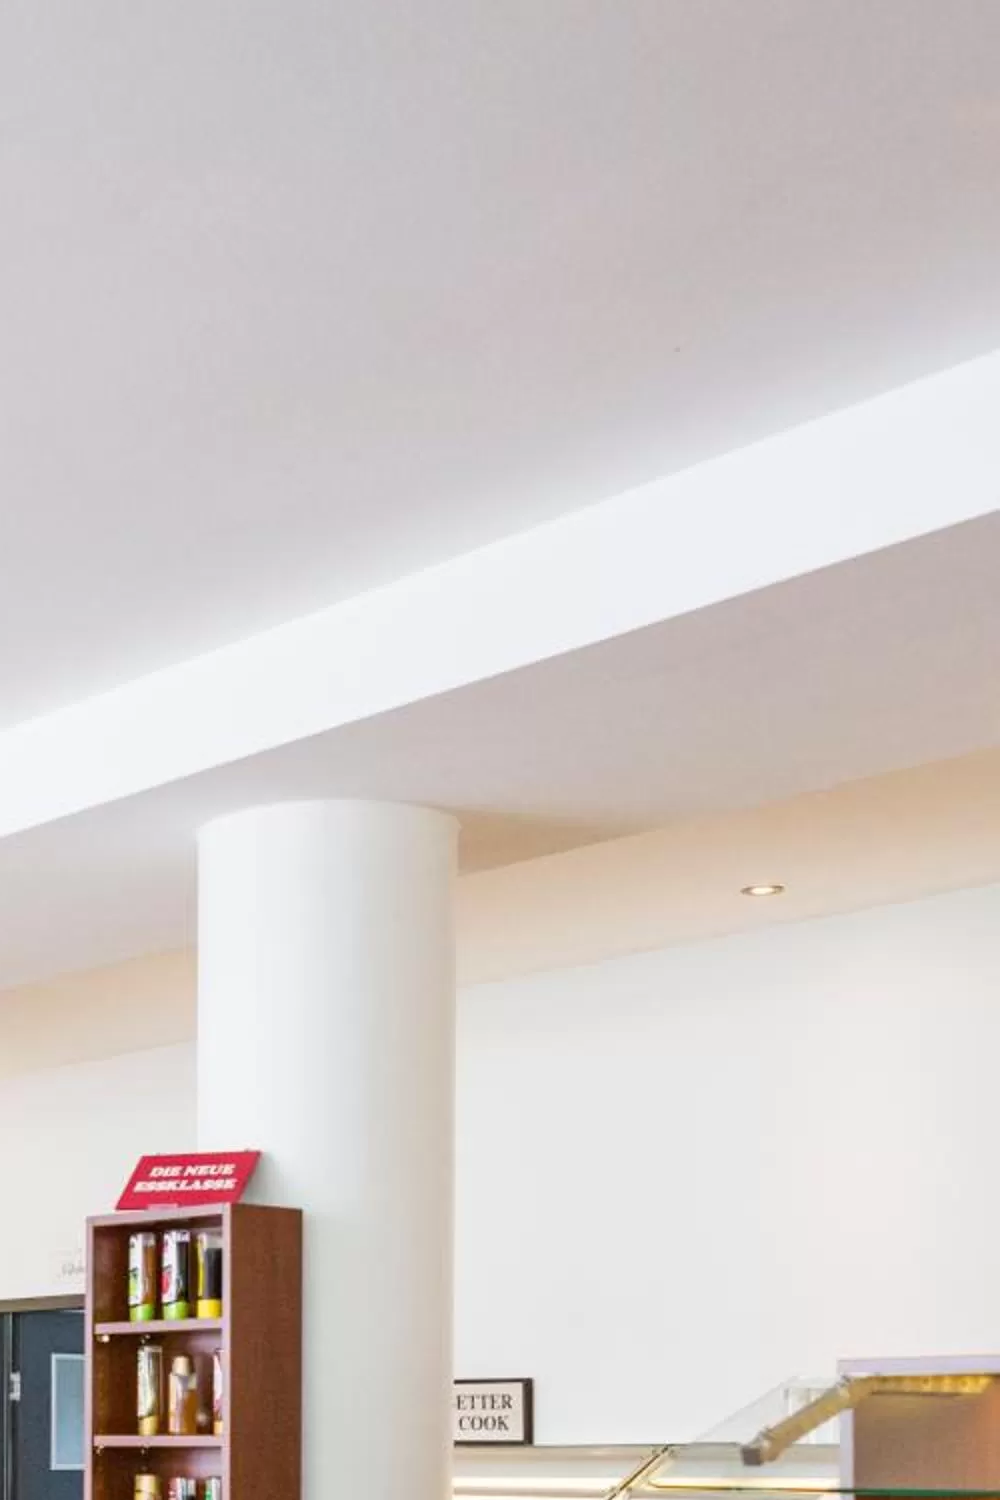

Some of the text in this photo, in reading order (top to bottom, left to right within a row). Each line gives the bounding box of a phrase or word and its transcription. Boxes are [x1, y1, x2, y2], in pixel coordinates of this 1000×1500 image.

[149, 1164, 236, 1177] DIE NEUE
[133, 1179, 238, 1193] ESSKLASSE
[455, 1393, 513, 1410] ETTER
[459, 1415, 510, 1431] COOK
